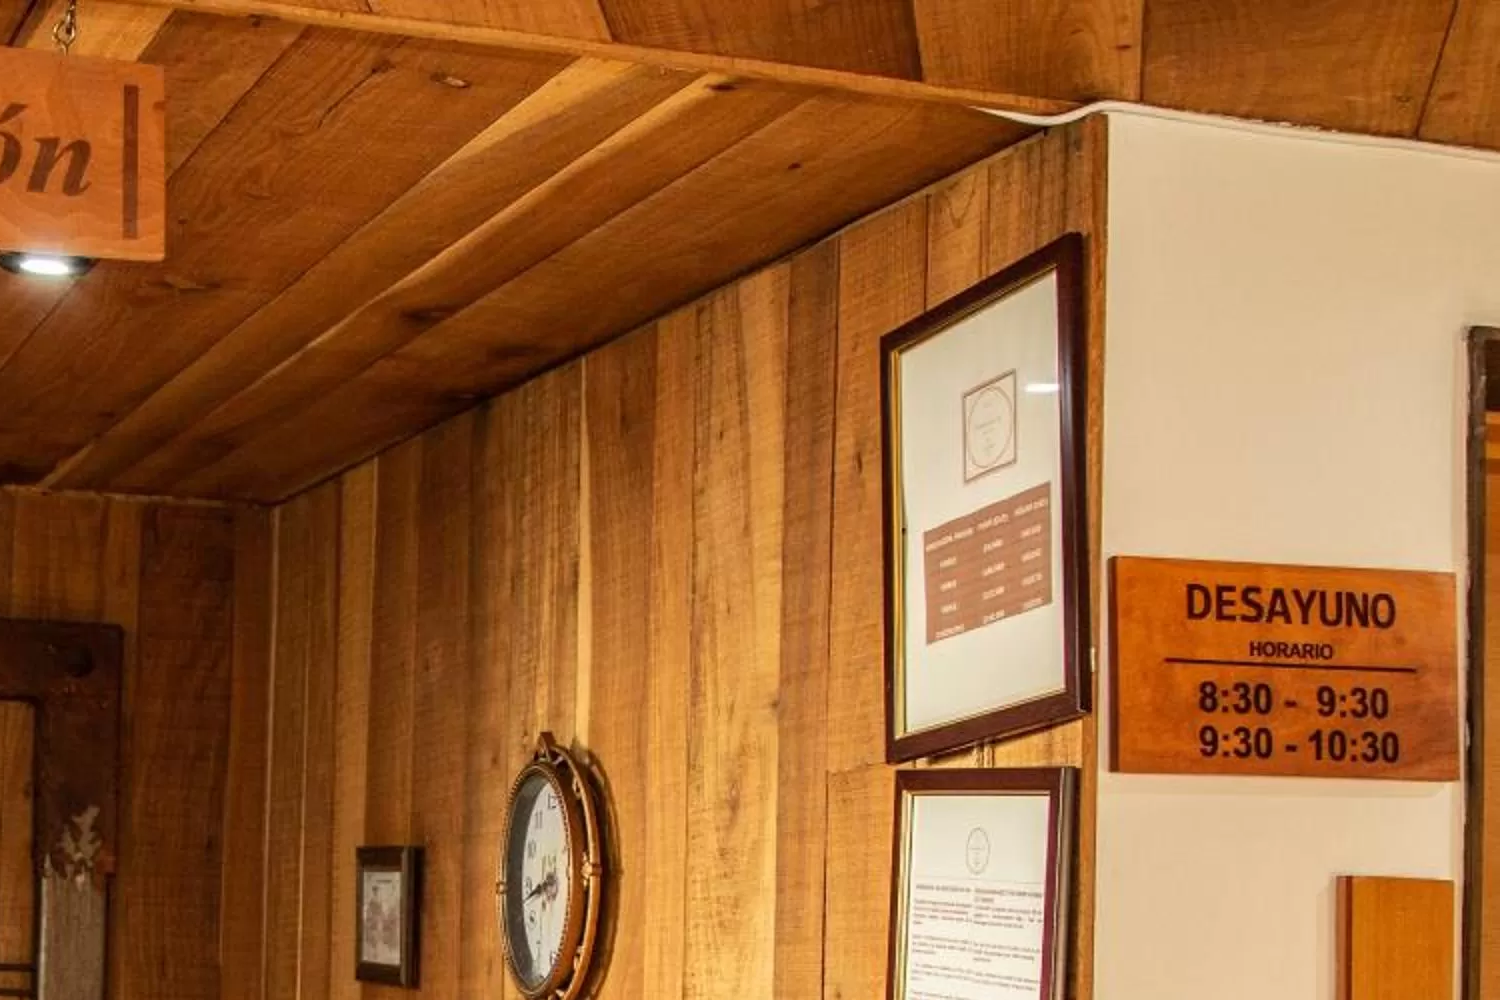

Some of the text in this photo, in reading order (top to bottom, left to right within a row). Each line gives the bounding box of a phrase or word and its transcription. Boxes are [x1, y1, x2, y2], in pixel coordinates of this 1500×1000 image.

[1186, 583, 1397, 629] DESAYUNO
[1249, 641, 1334, 661] HORARIO
[1198, 681, 1273, 715] 8:30
[1315, 686, 1390, 720] 9:30
[1198, 727, 1274, 760] 9:30
[1307, 730, 1400, 764] 10:30
